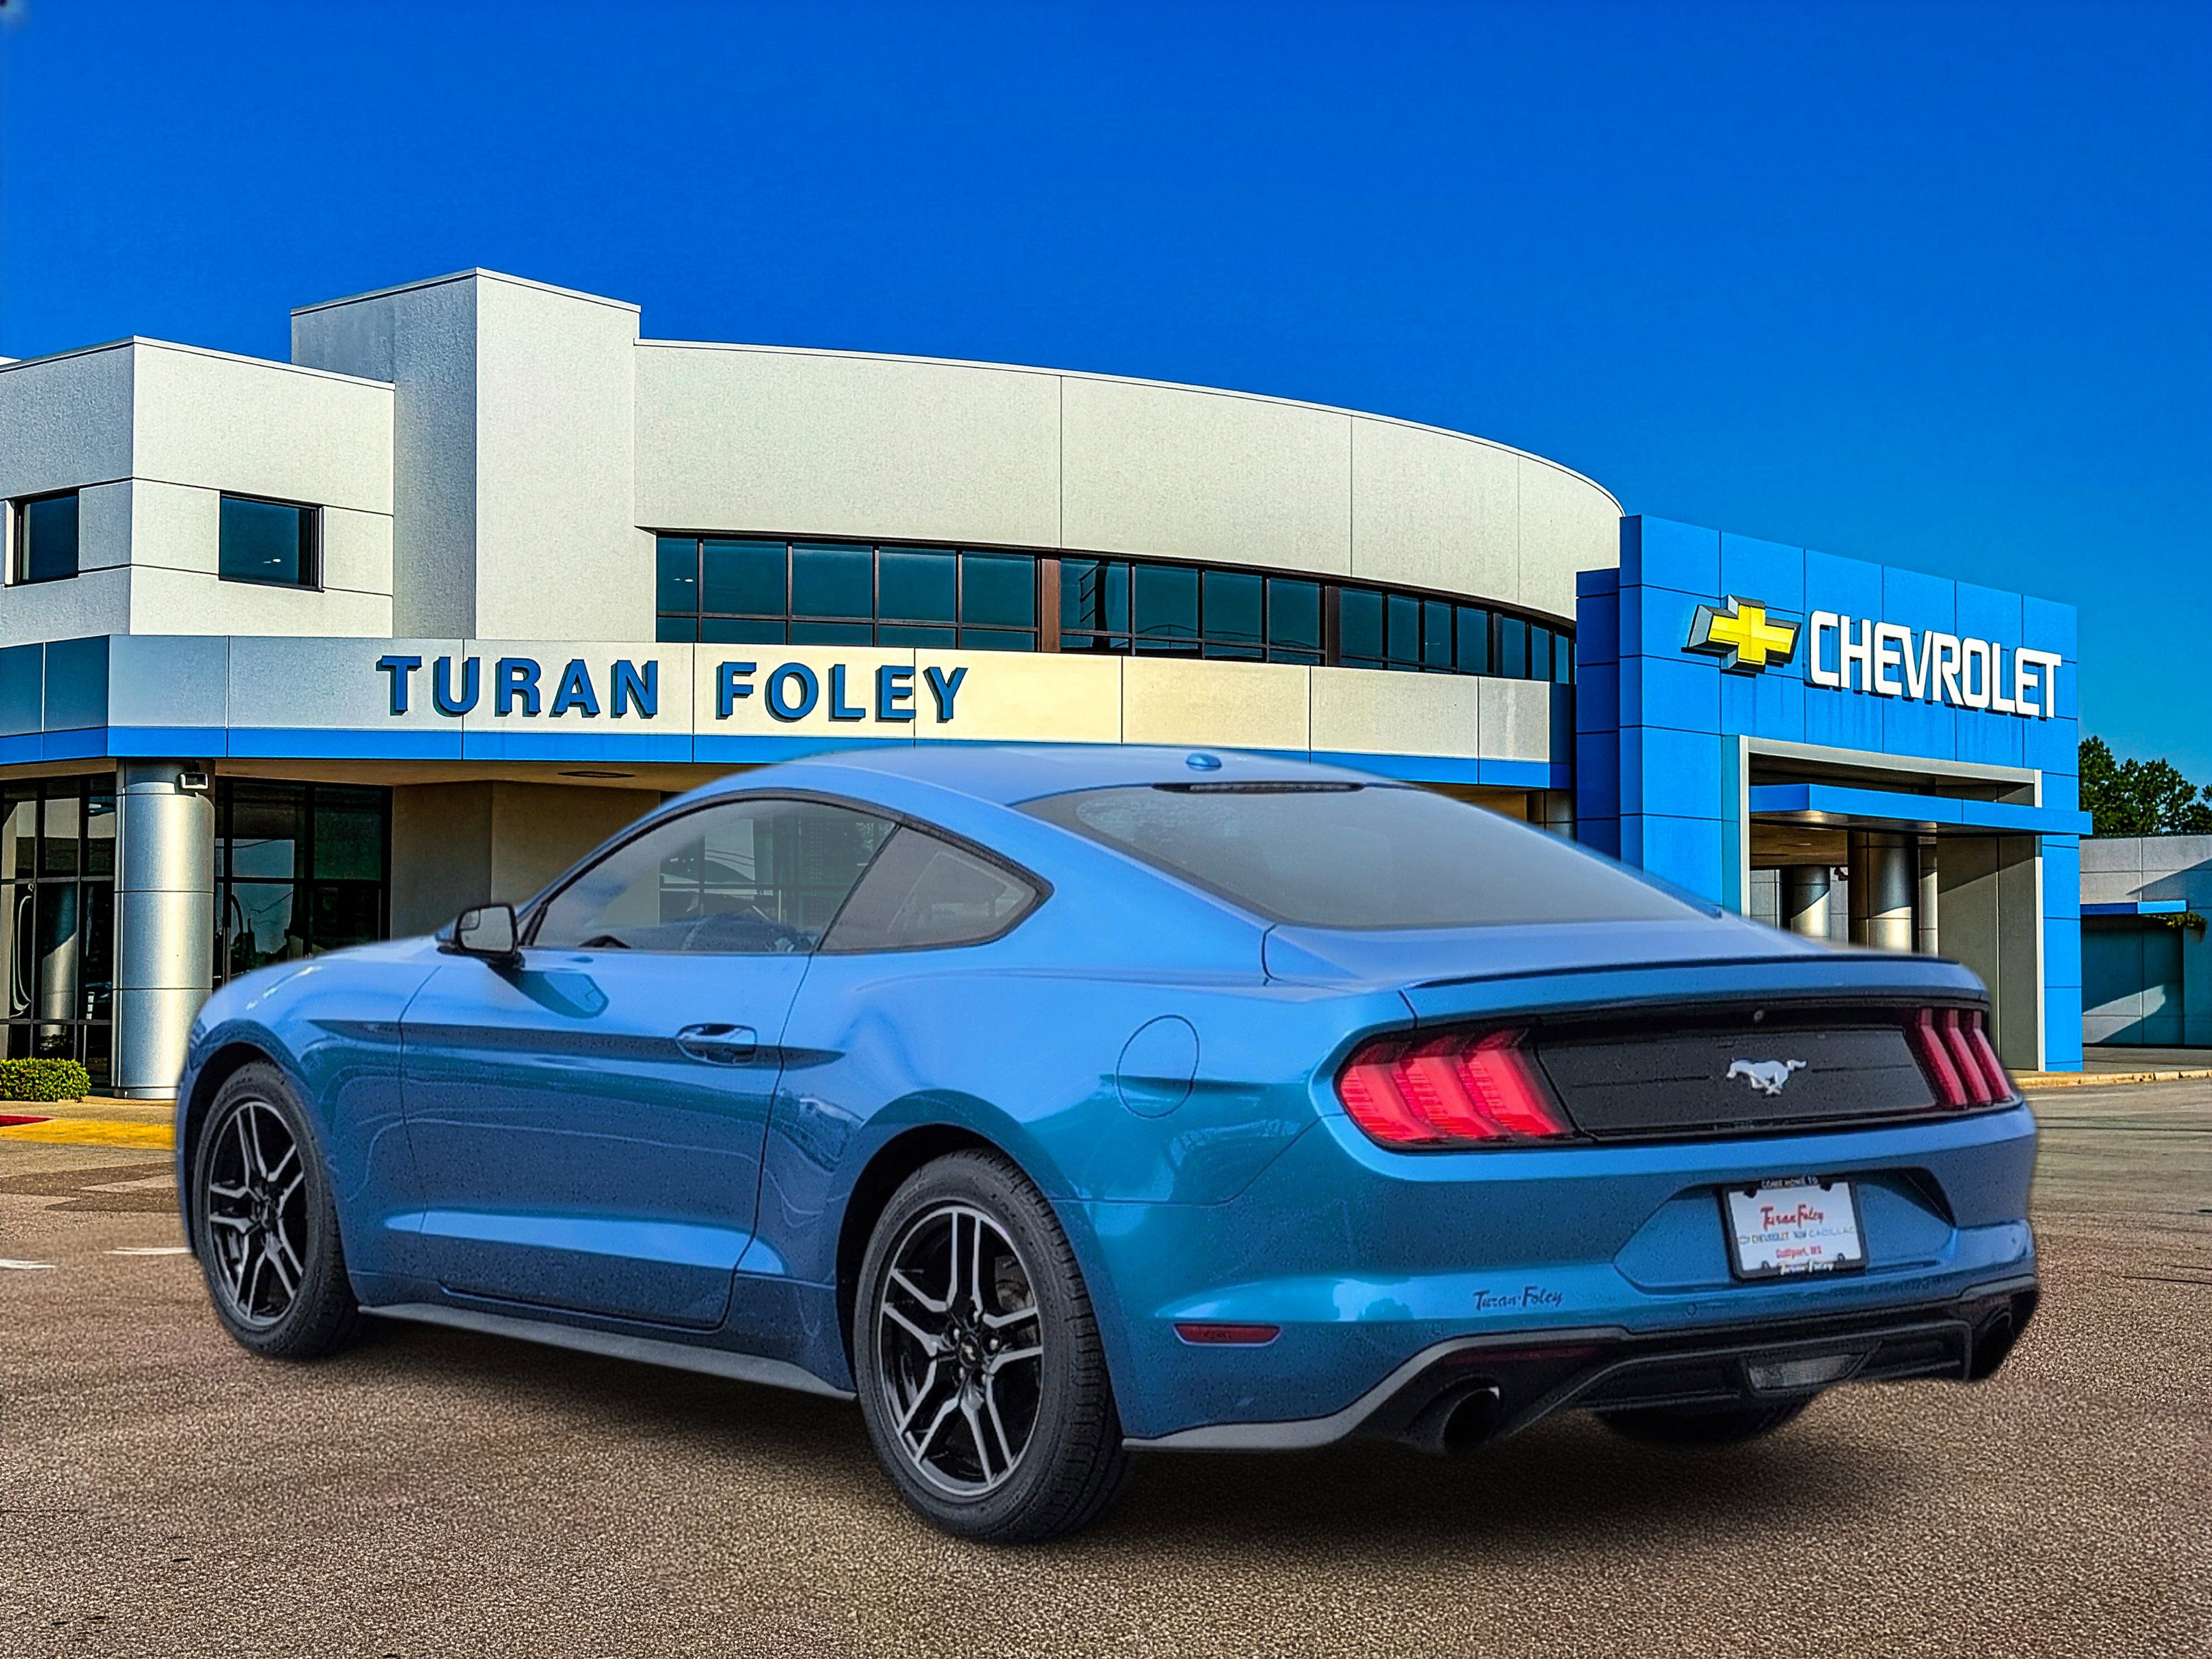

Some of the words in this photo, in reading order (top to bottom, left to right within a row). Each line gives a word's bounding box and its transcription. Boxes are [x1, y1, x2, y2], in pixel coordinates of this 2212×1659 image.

[376, 655, 659, 717] TURAN
[716, 661, 968, 723] FOLEY
[1805, 609, 2062, 719] CHEVROLET
